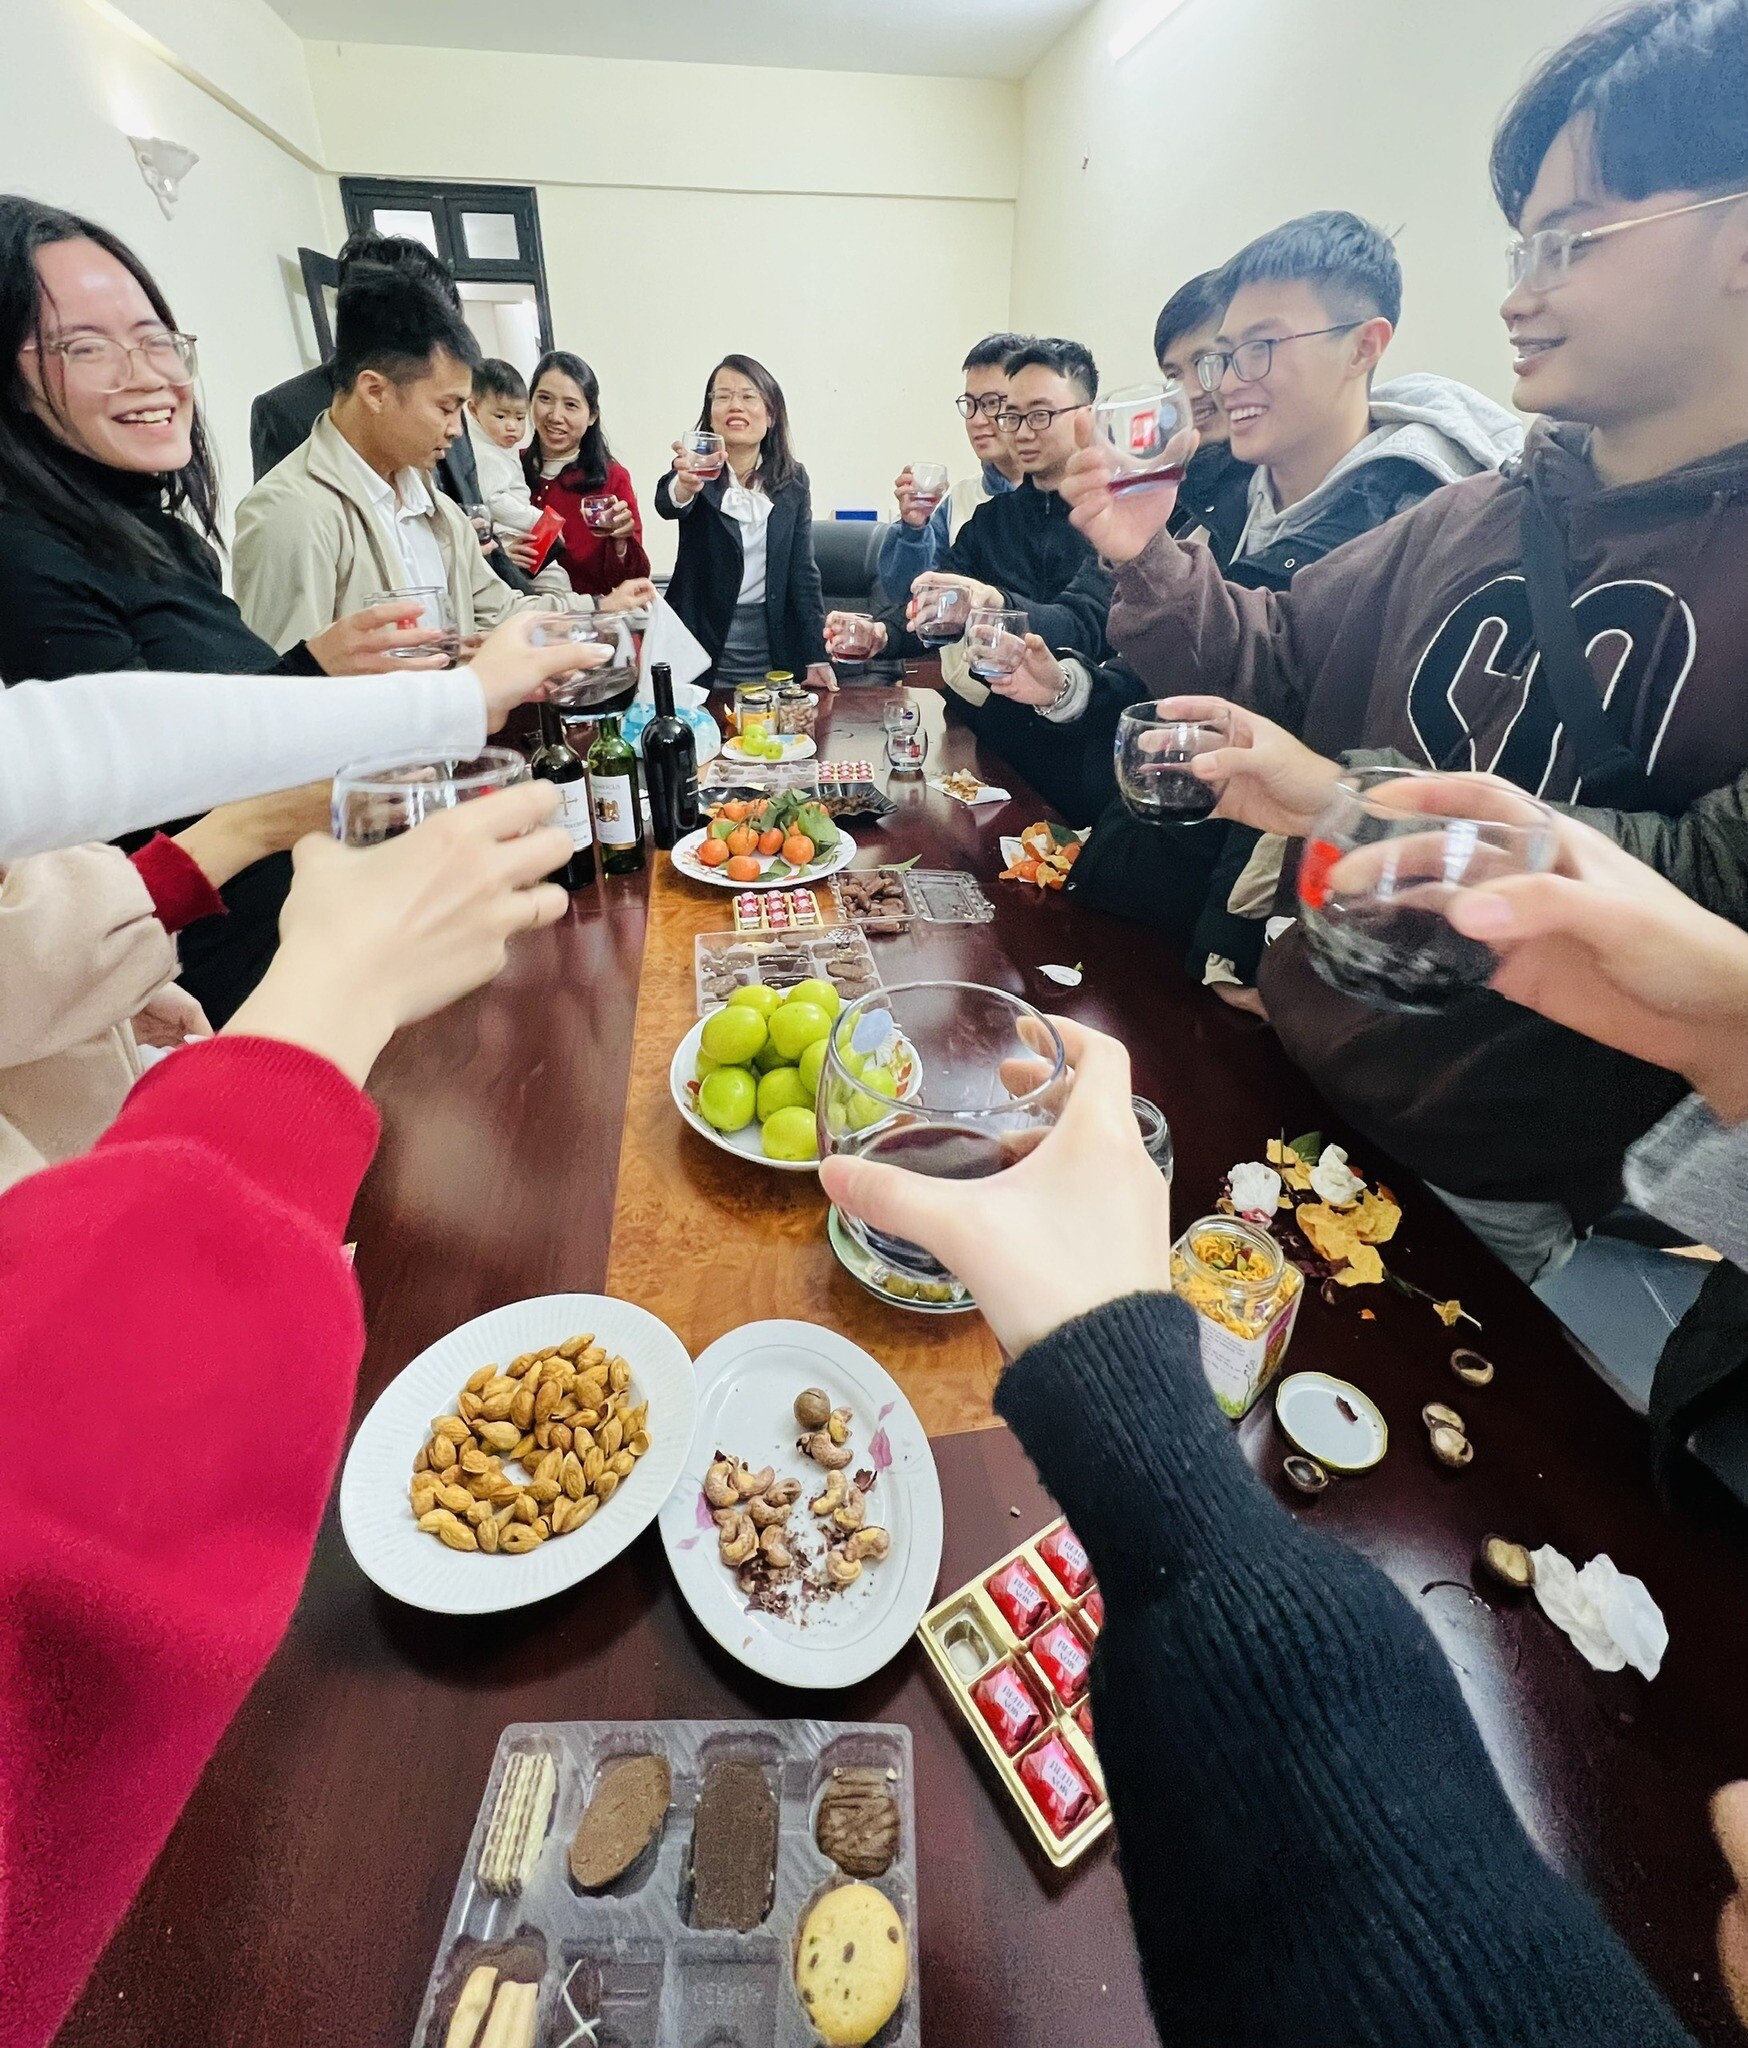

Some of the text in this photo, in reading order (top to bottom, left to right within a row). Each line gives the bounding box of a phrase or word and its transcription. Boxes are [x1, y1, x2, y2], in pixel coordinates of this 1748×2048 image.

[1016, 1589, 1029, 1605] MON
[1060, 1652, 1074, 1669] MON
[1002, 1685, 1030, 1714] CHERI
[1004, 1699, 1019, 1718] MON
[1050, 1760, 1080, 1792] CHERI
[1052, 1776, 1067, 1796] MON
